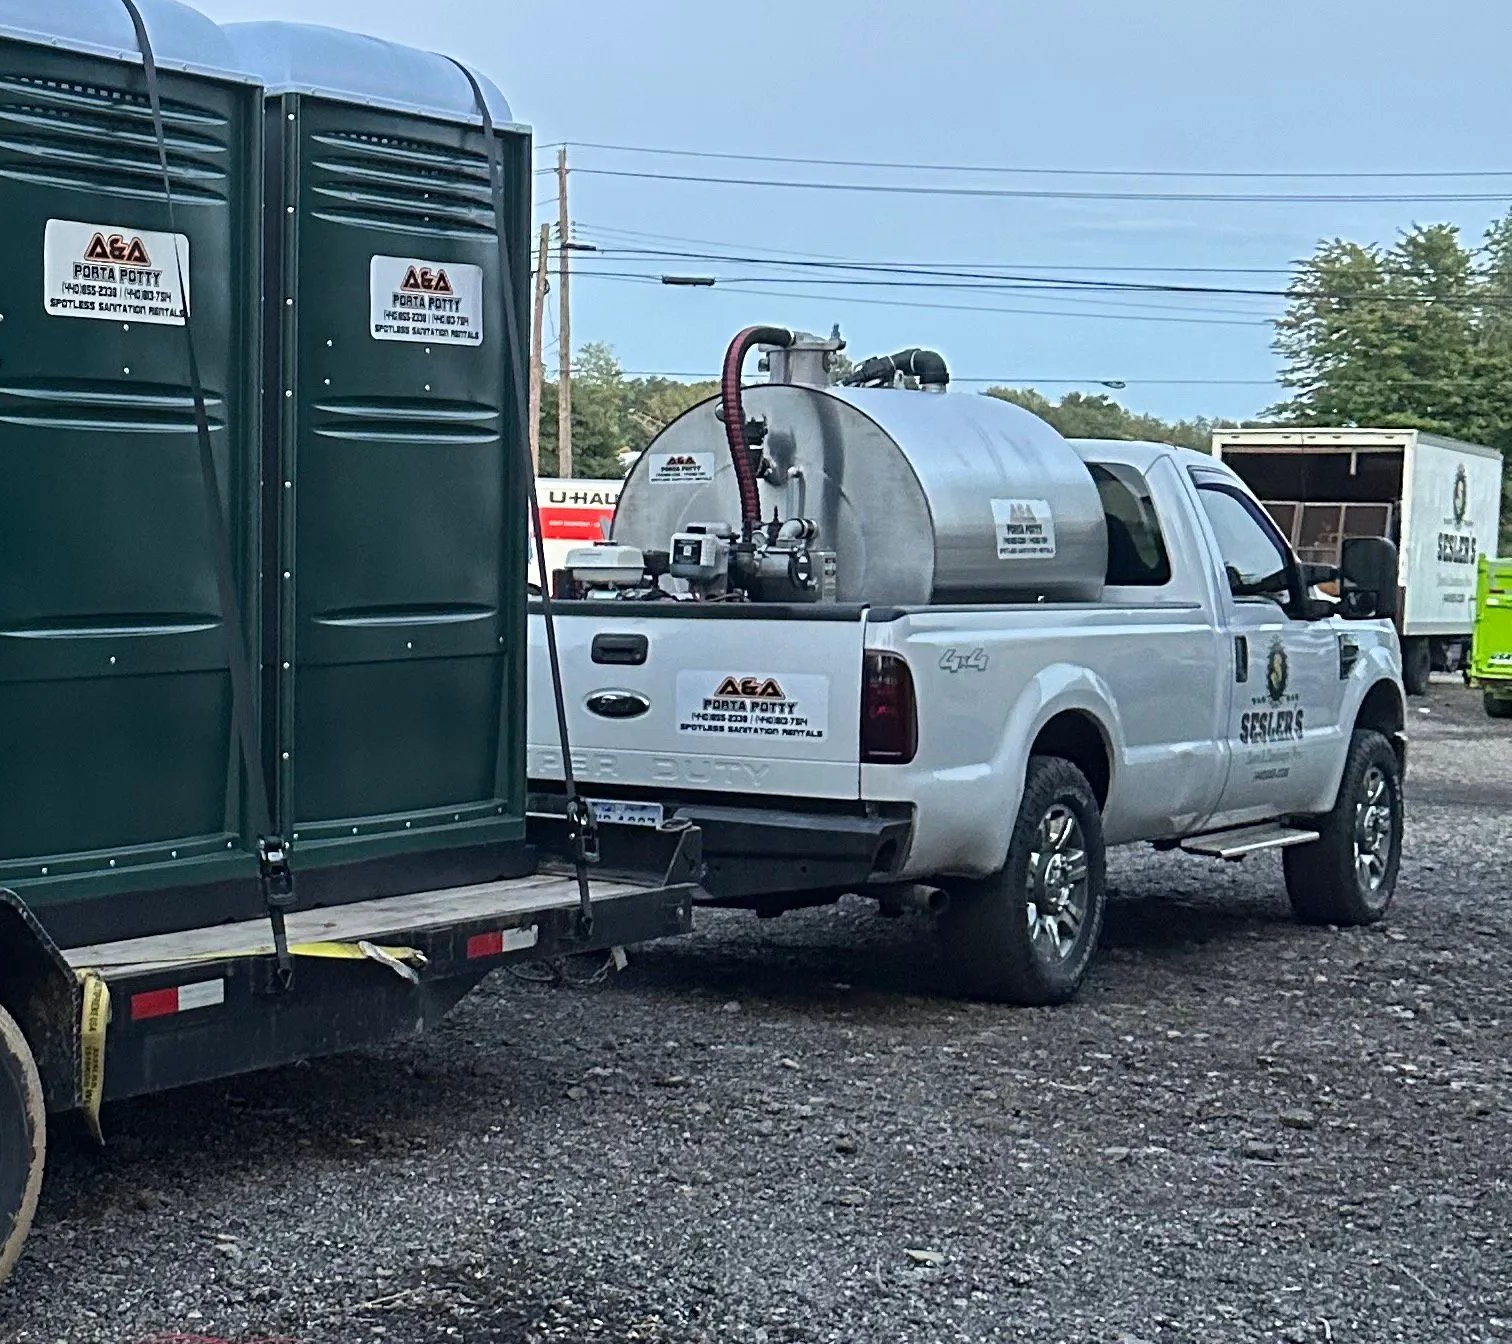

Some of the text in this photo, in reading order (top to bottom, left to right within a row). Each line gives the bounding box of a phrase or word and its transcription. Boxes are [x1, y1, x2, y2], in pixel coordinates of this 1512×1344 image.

[84, 232, 151, 267] A&A
[73, 261, 162, 287] PORTA POTTY
[400, 265, 453, 295] A&A
[50, 298, 185, 318] SPOTLESS SANITATION RENTALS
[392, 292, 462, 313] PORTA POTTY
[666, 456, 696, 466] A&A
[549, 491, 620, 505] U-HAU
[713, 676, 786, 700] A&A
[702, 698, 798, 715] PORTA POTTY
[680, 723, 823, 739] SPOTLESS SANITATION RENTALS
[1239, 703, 1304, 745] SESLER'S
[652, 756, 770, 787] DUTY
